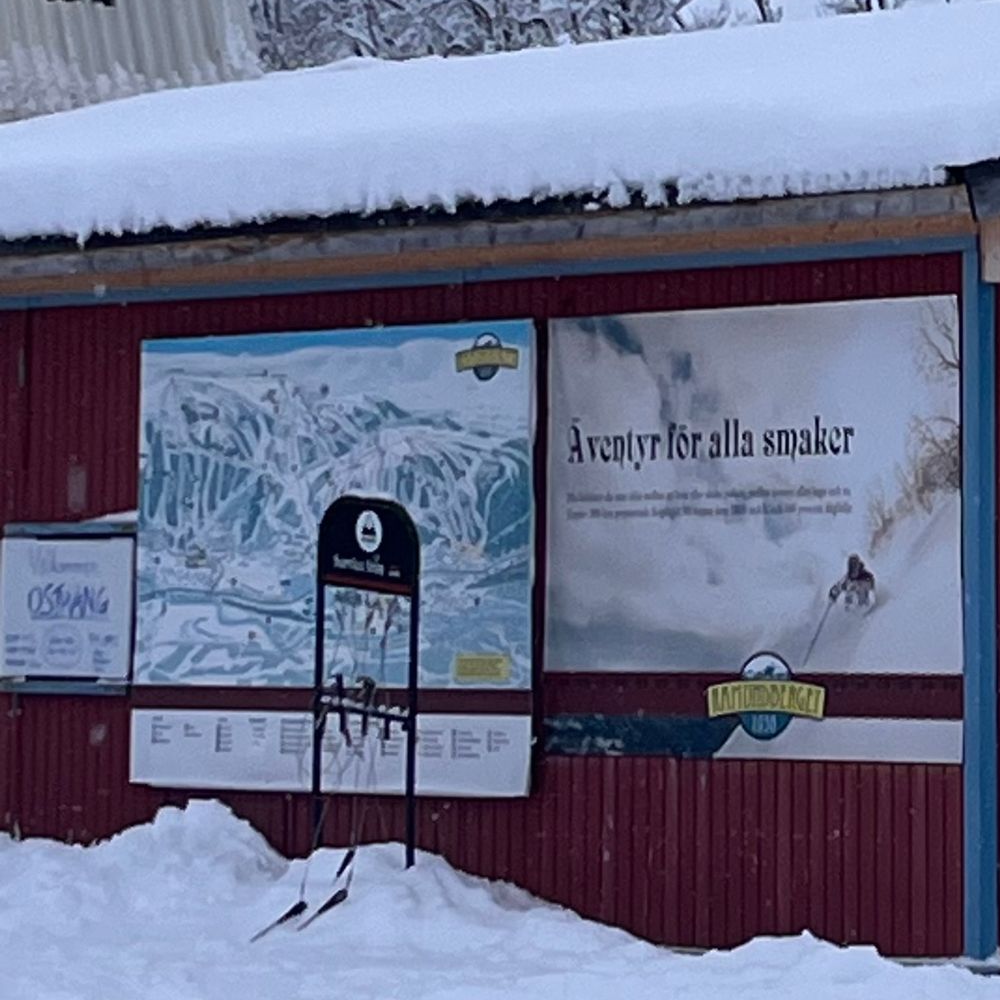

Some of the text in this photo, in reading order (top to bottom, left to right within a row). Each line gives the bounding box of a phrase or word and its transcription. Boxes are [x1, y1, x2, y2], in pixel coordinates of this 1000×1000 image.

[567, 415, 855, 471] Äventyr för alla smaker
